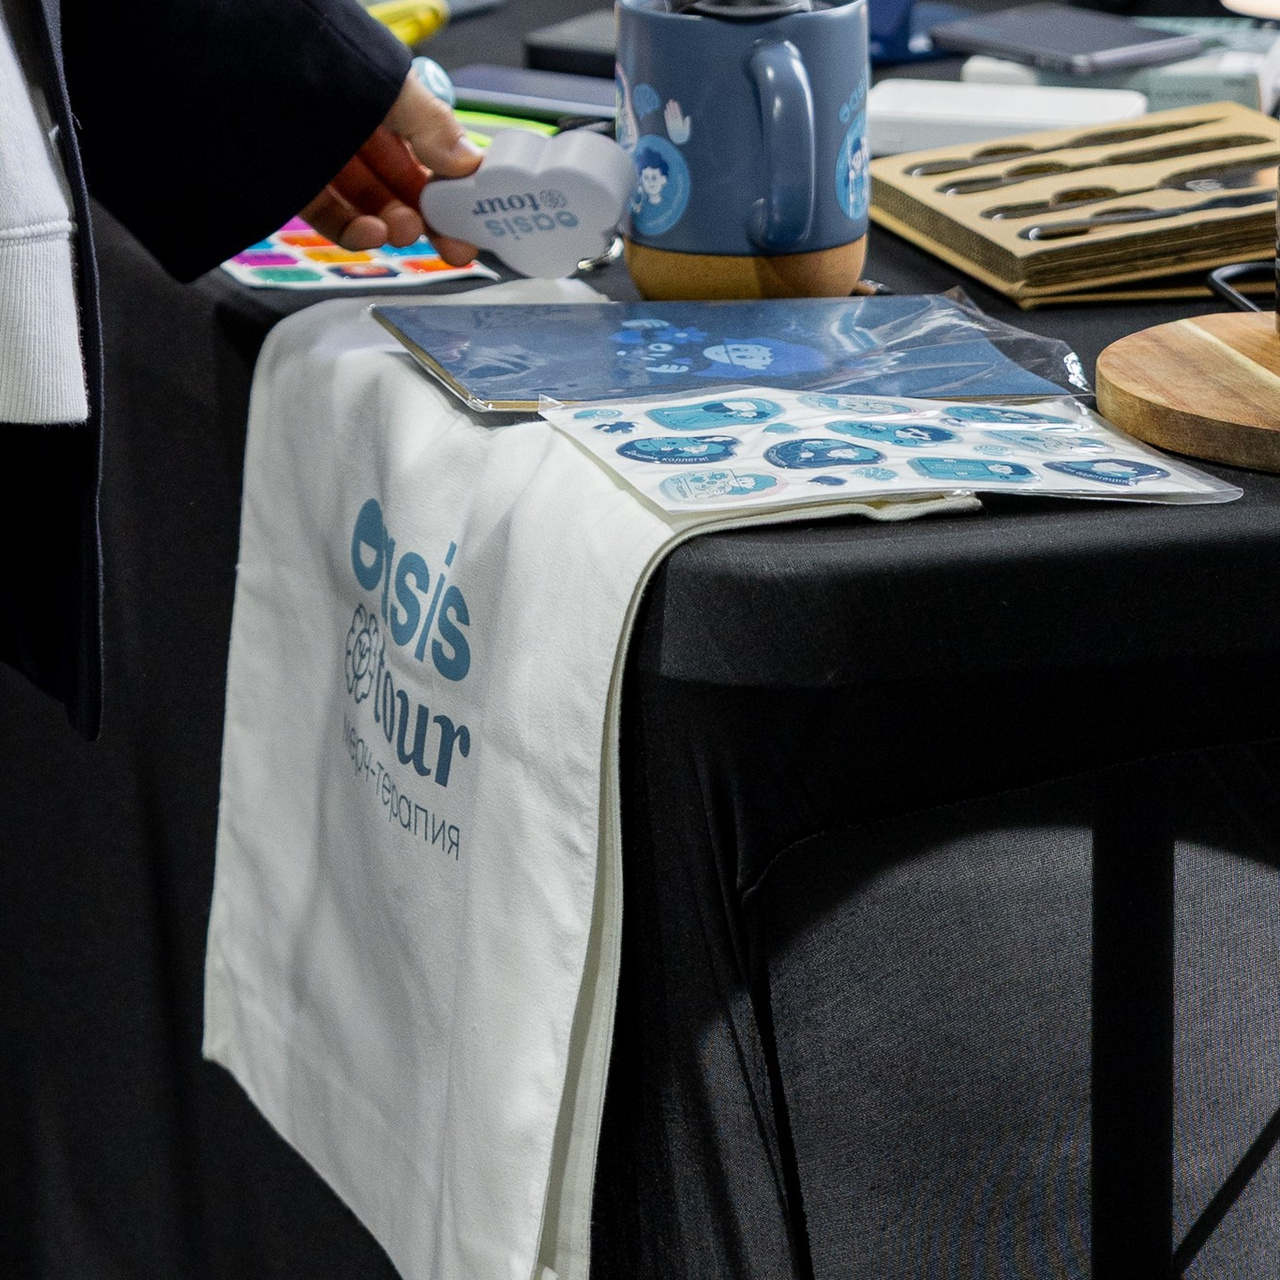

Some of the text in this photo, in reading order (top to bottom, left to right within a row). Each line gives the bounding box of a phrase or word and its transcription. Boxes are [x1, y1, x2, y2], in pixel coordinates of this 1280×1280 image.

[472, 192, 540, 217] tour
[483, 211, 579, 239] oasis
[374, 651, 470, 788] tour
